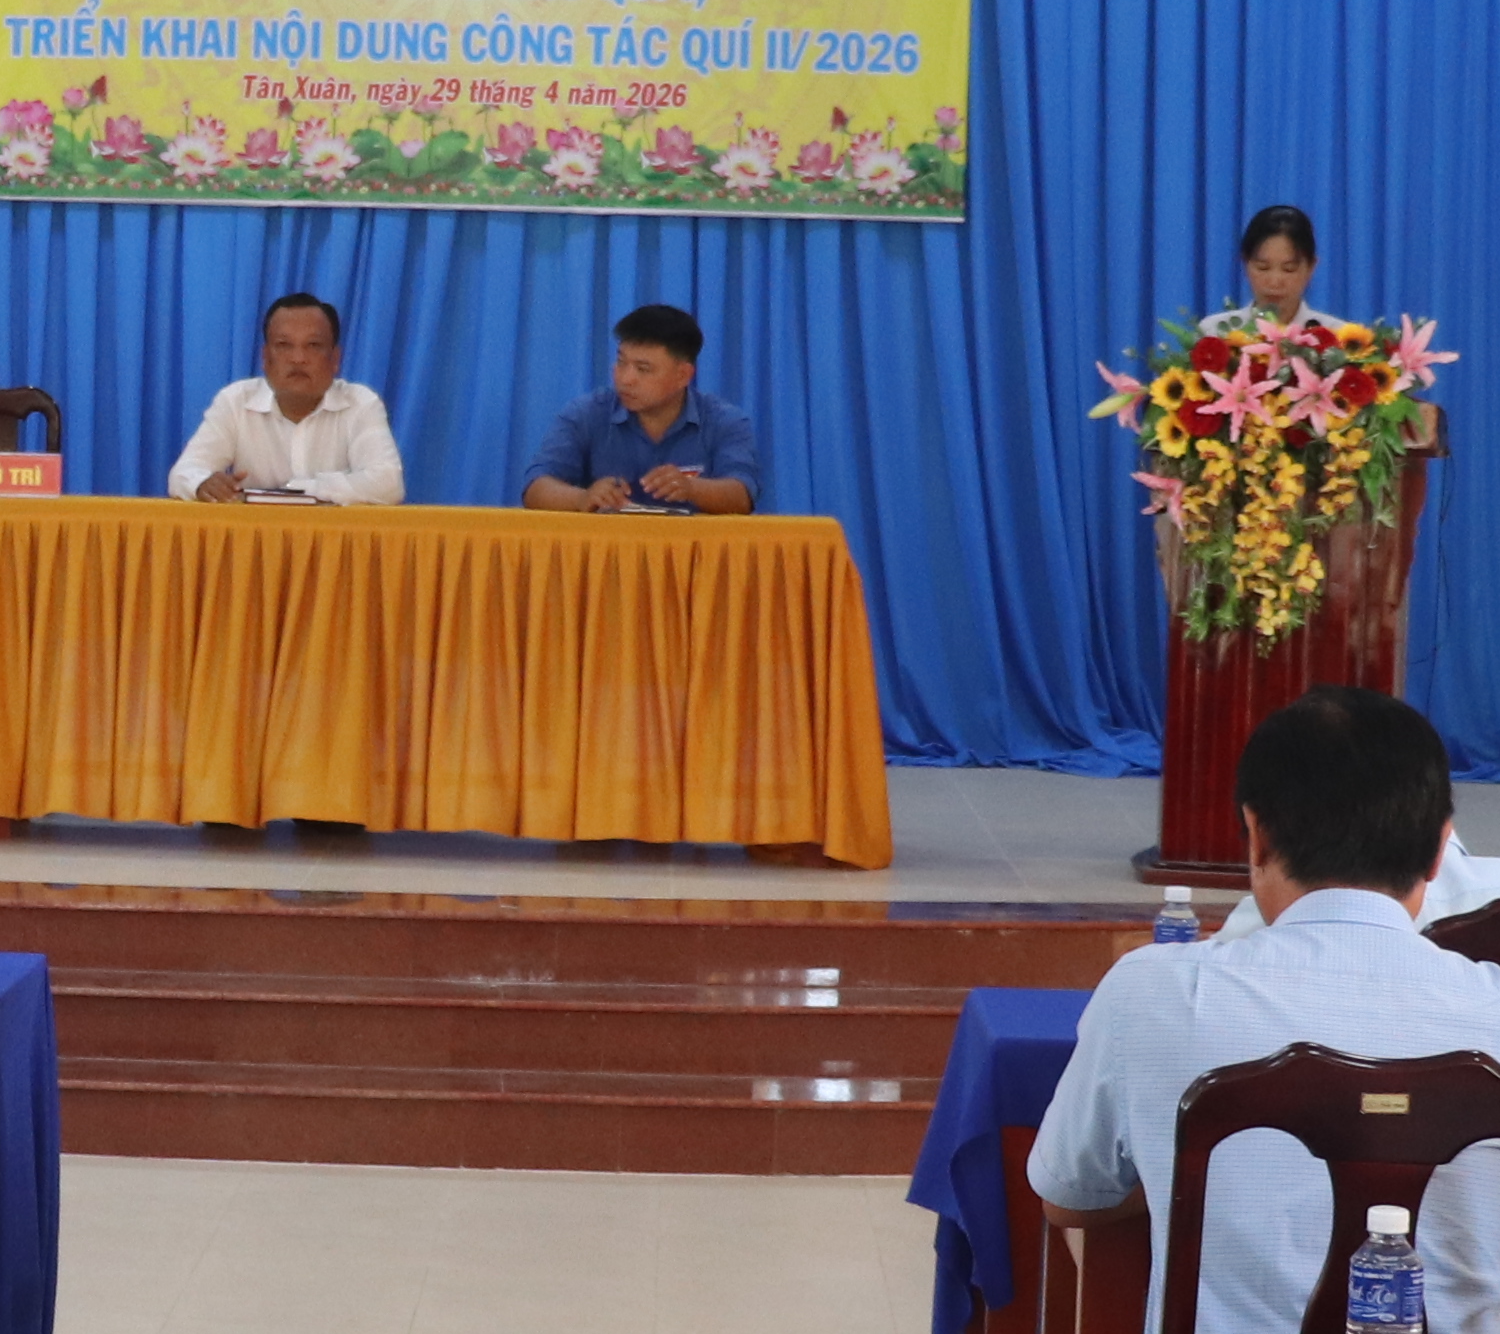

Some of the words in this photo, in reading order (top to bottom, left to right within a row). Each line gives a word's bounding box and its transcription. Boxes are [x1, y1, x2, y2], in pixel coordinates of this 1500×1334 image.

[141, 17, 239, 59] KHAI
[252, 8, 323, 68] NỘI
[337, 20, 449, 63] DUNG
[461, 12, 574, 65] CÔNG
[585, 14, 669, 68] TÁC
[680, 18, 755, 76] QUÍ
[243, 75, 285, 100] Tân
[292, 76, 357, 103] Xuân,
[367, 78, 423, 107] ngày
[430, 78, 461, 103] 29
[545, 81, 559, 104] 4
[568, 83, 617, 105] năm
[625, 83, 686, 107] 2026
[9, 465, 42, 486] TRÌ
